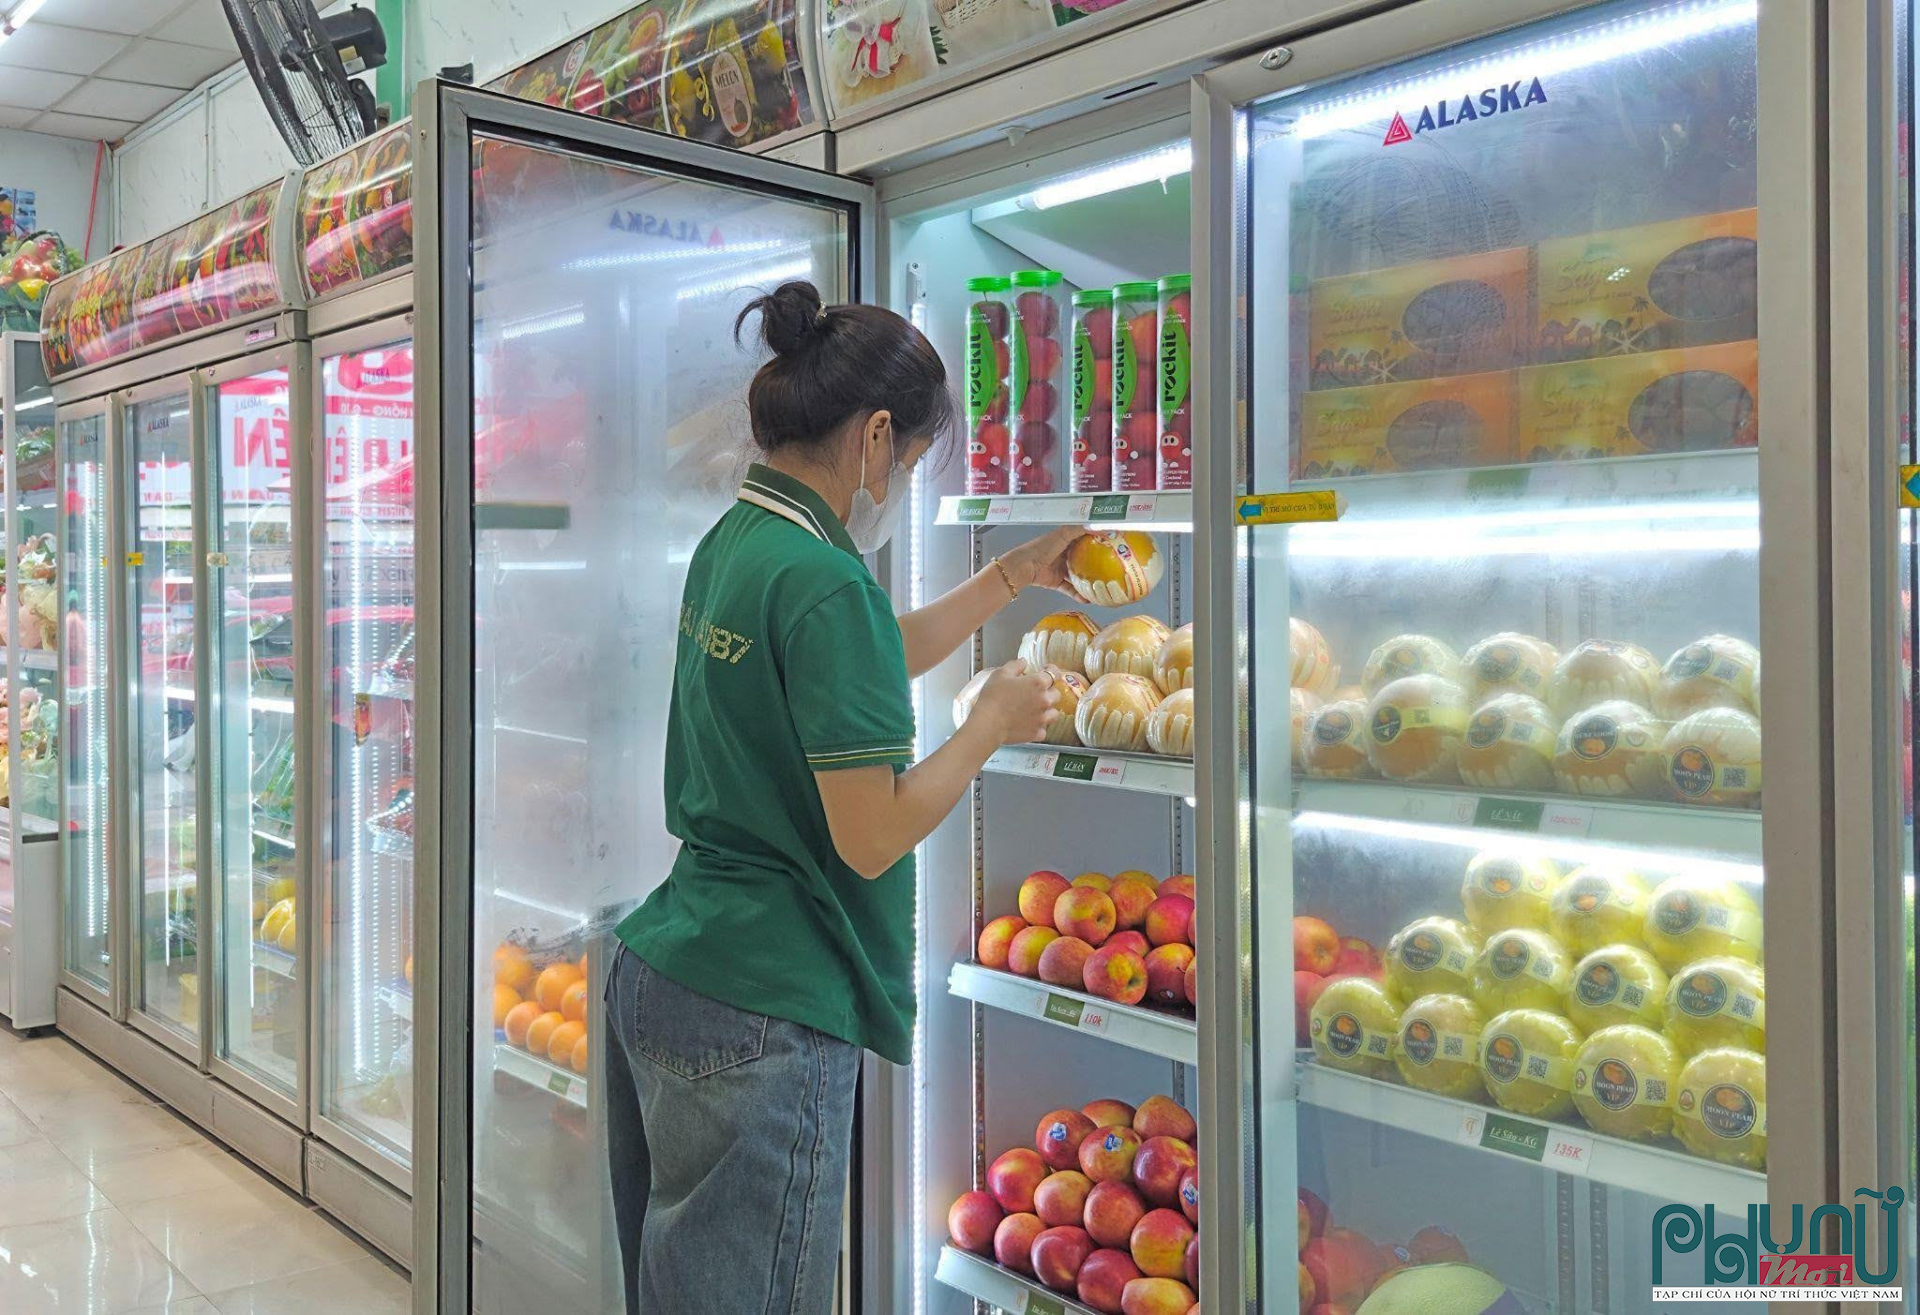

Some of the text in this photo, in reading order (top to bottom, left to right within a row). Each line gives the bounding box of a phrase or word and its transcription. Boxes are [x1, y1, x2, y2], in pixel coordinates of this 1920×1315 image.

[1414, 76, 1548, 134] ALASKA
[1162, 331, 1177, 402] rockit
[1707, 1105, 1752, 1121] MOON PEAR
[1553, 1142, 1583, 1159] 135K
